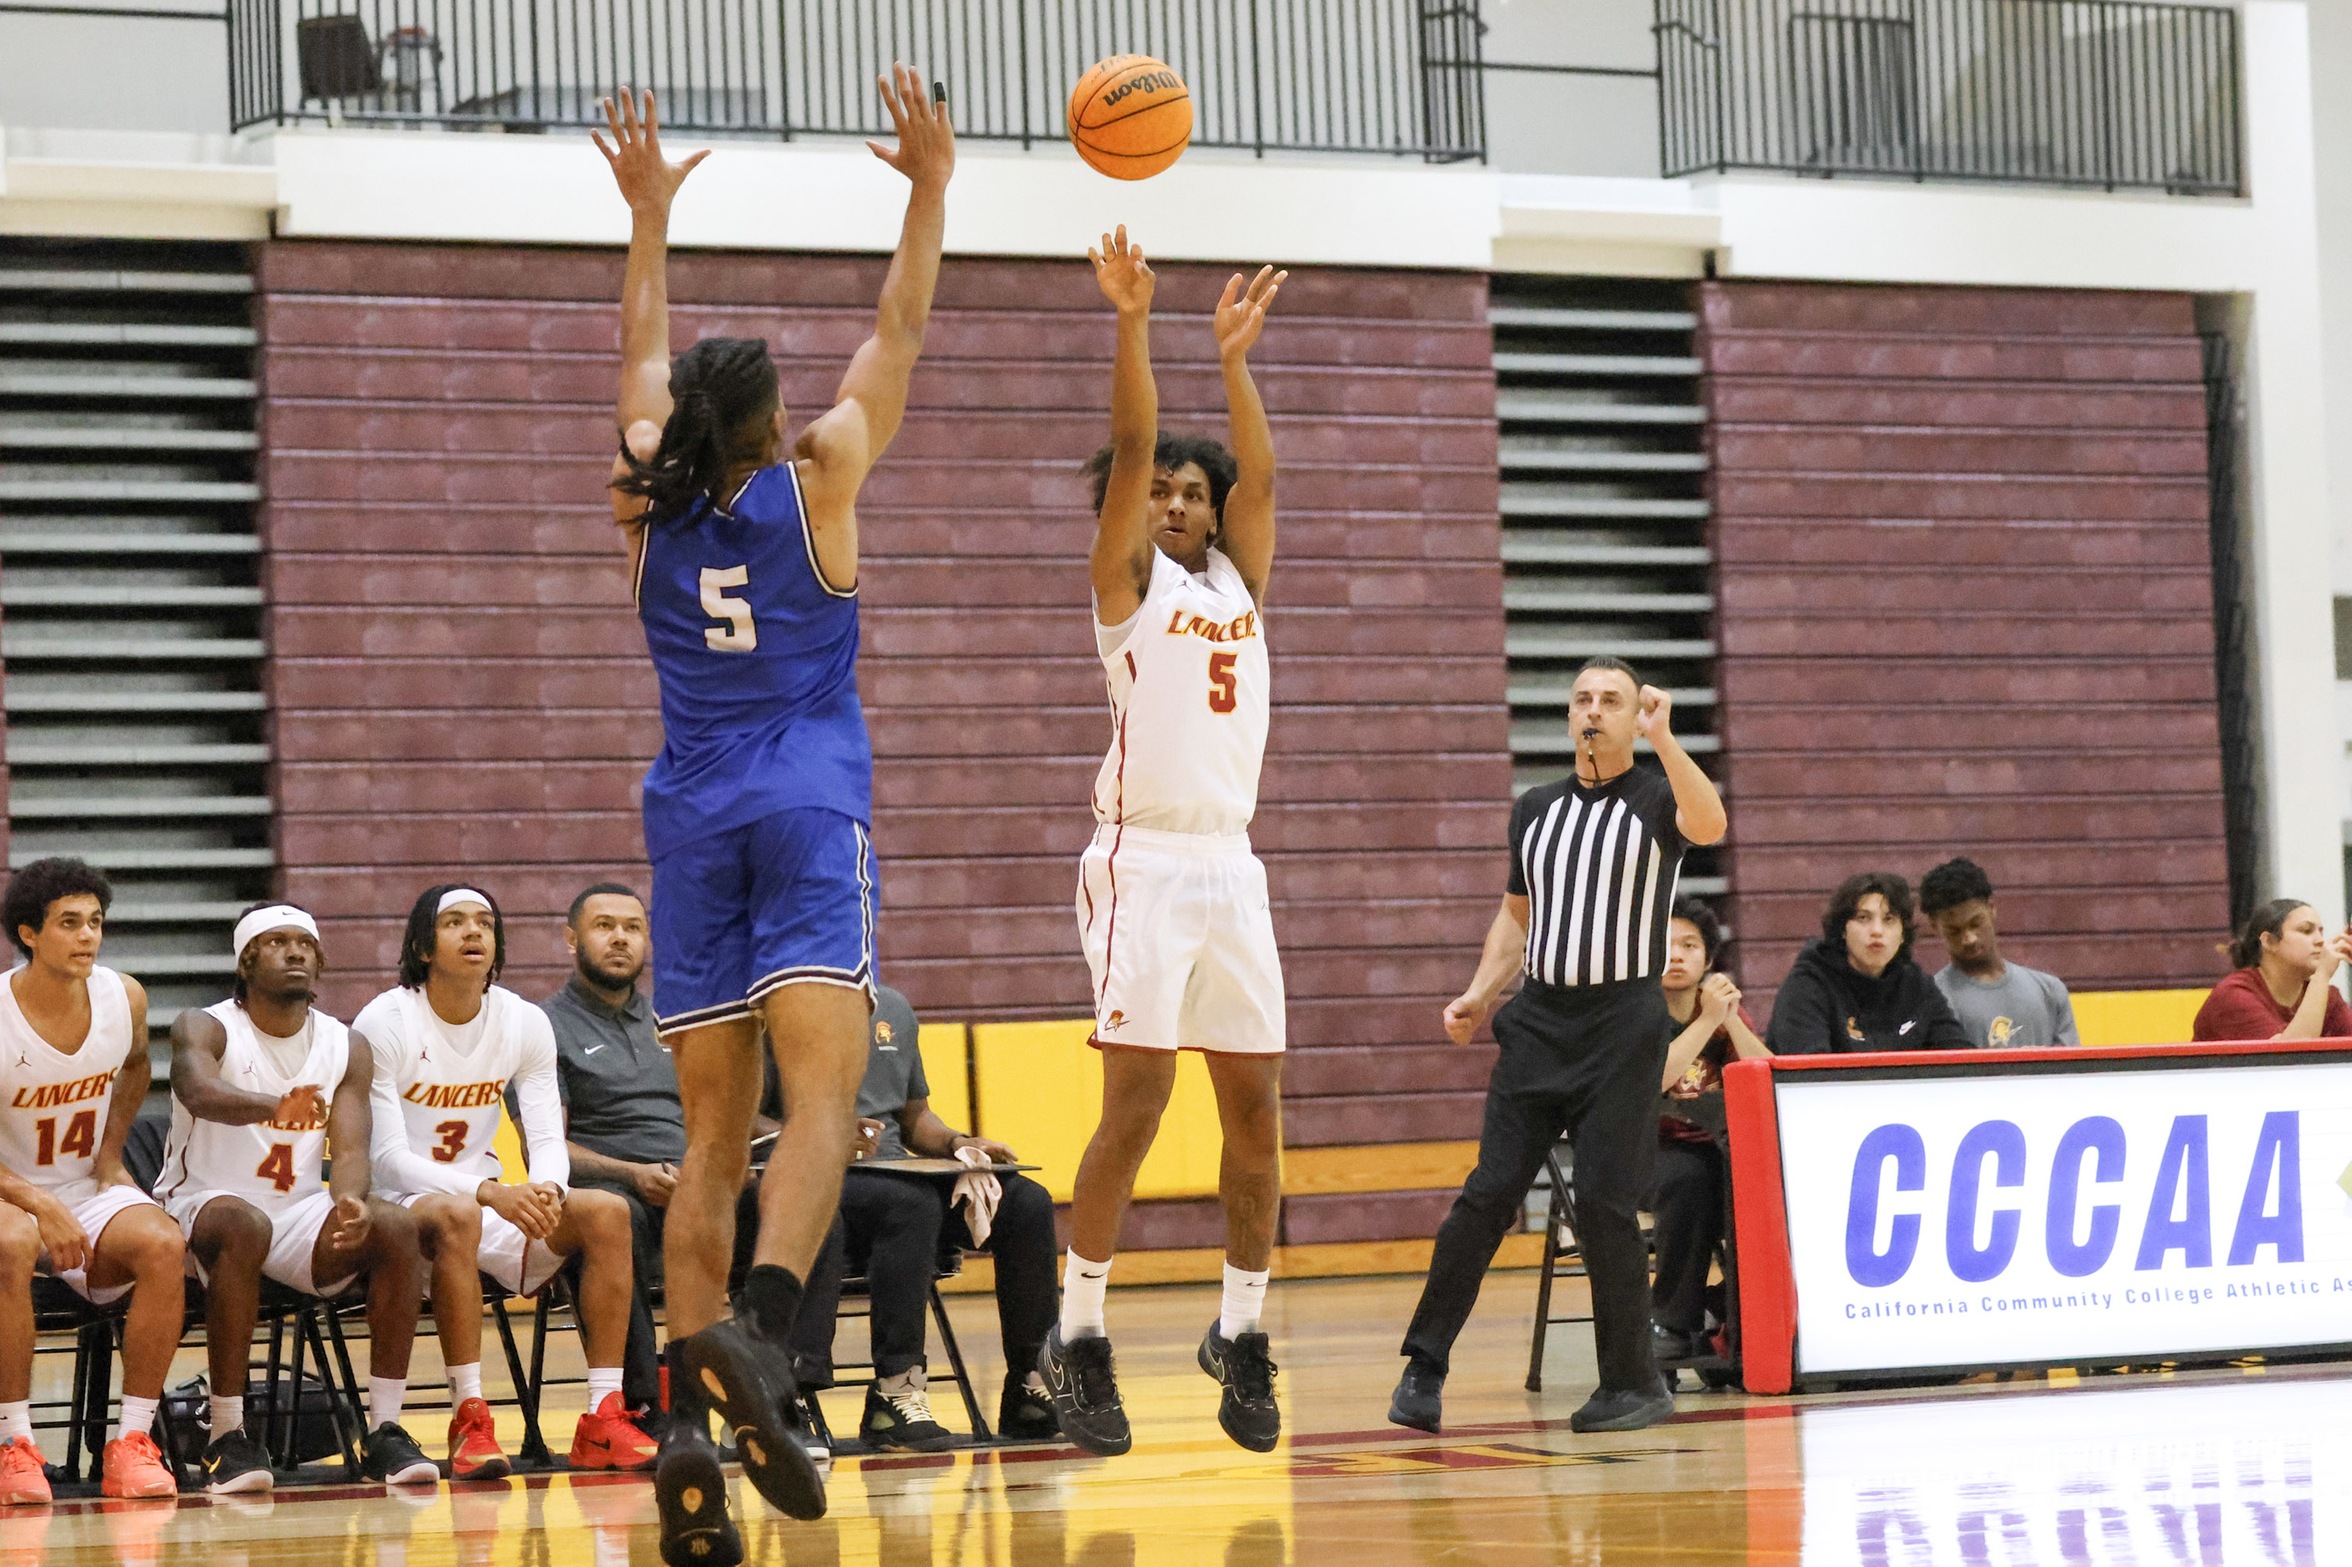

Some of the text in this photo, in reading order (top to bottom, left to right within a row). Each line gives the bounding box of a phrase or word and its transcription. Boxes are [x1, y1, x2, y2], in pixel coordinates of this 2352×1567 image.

[1102, 70, 1181, 106] Wilson
[699, 564, 758, 653] 5
[1165, 609, 1257, 643] LANCER
[1208, 651, 1239, 715] 5
[402, 1078, 505, 1108] LANCERS
[35, 1109, 97, 1167] 14
[431, 1119, 470, 1164] 3
[256, 1143, 296, 1193] 4
[1845, 1110, 2305, 1288] CCCAA
[1845, 1299, 1968, 1319] California
[1981, 1291, 2112, 1312] Community
[2125, 1286, 2214, 1304] College
[2226, 1279, 2320, 1298] Athletic
